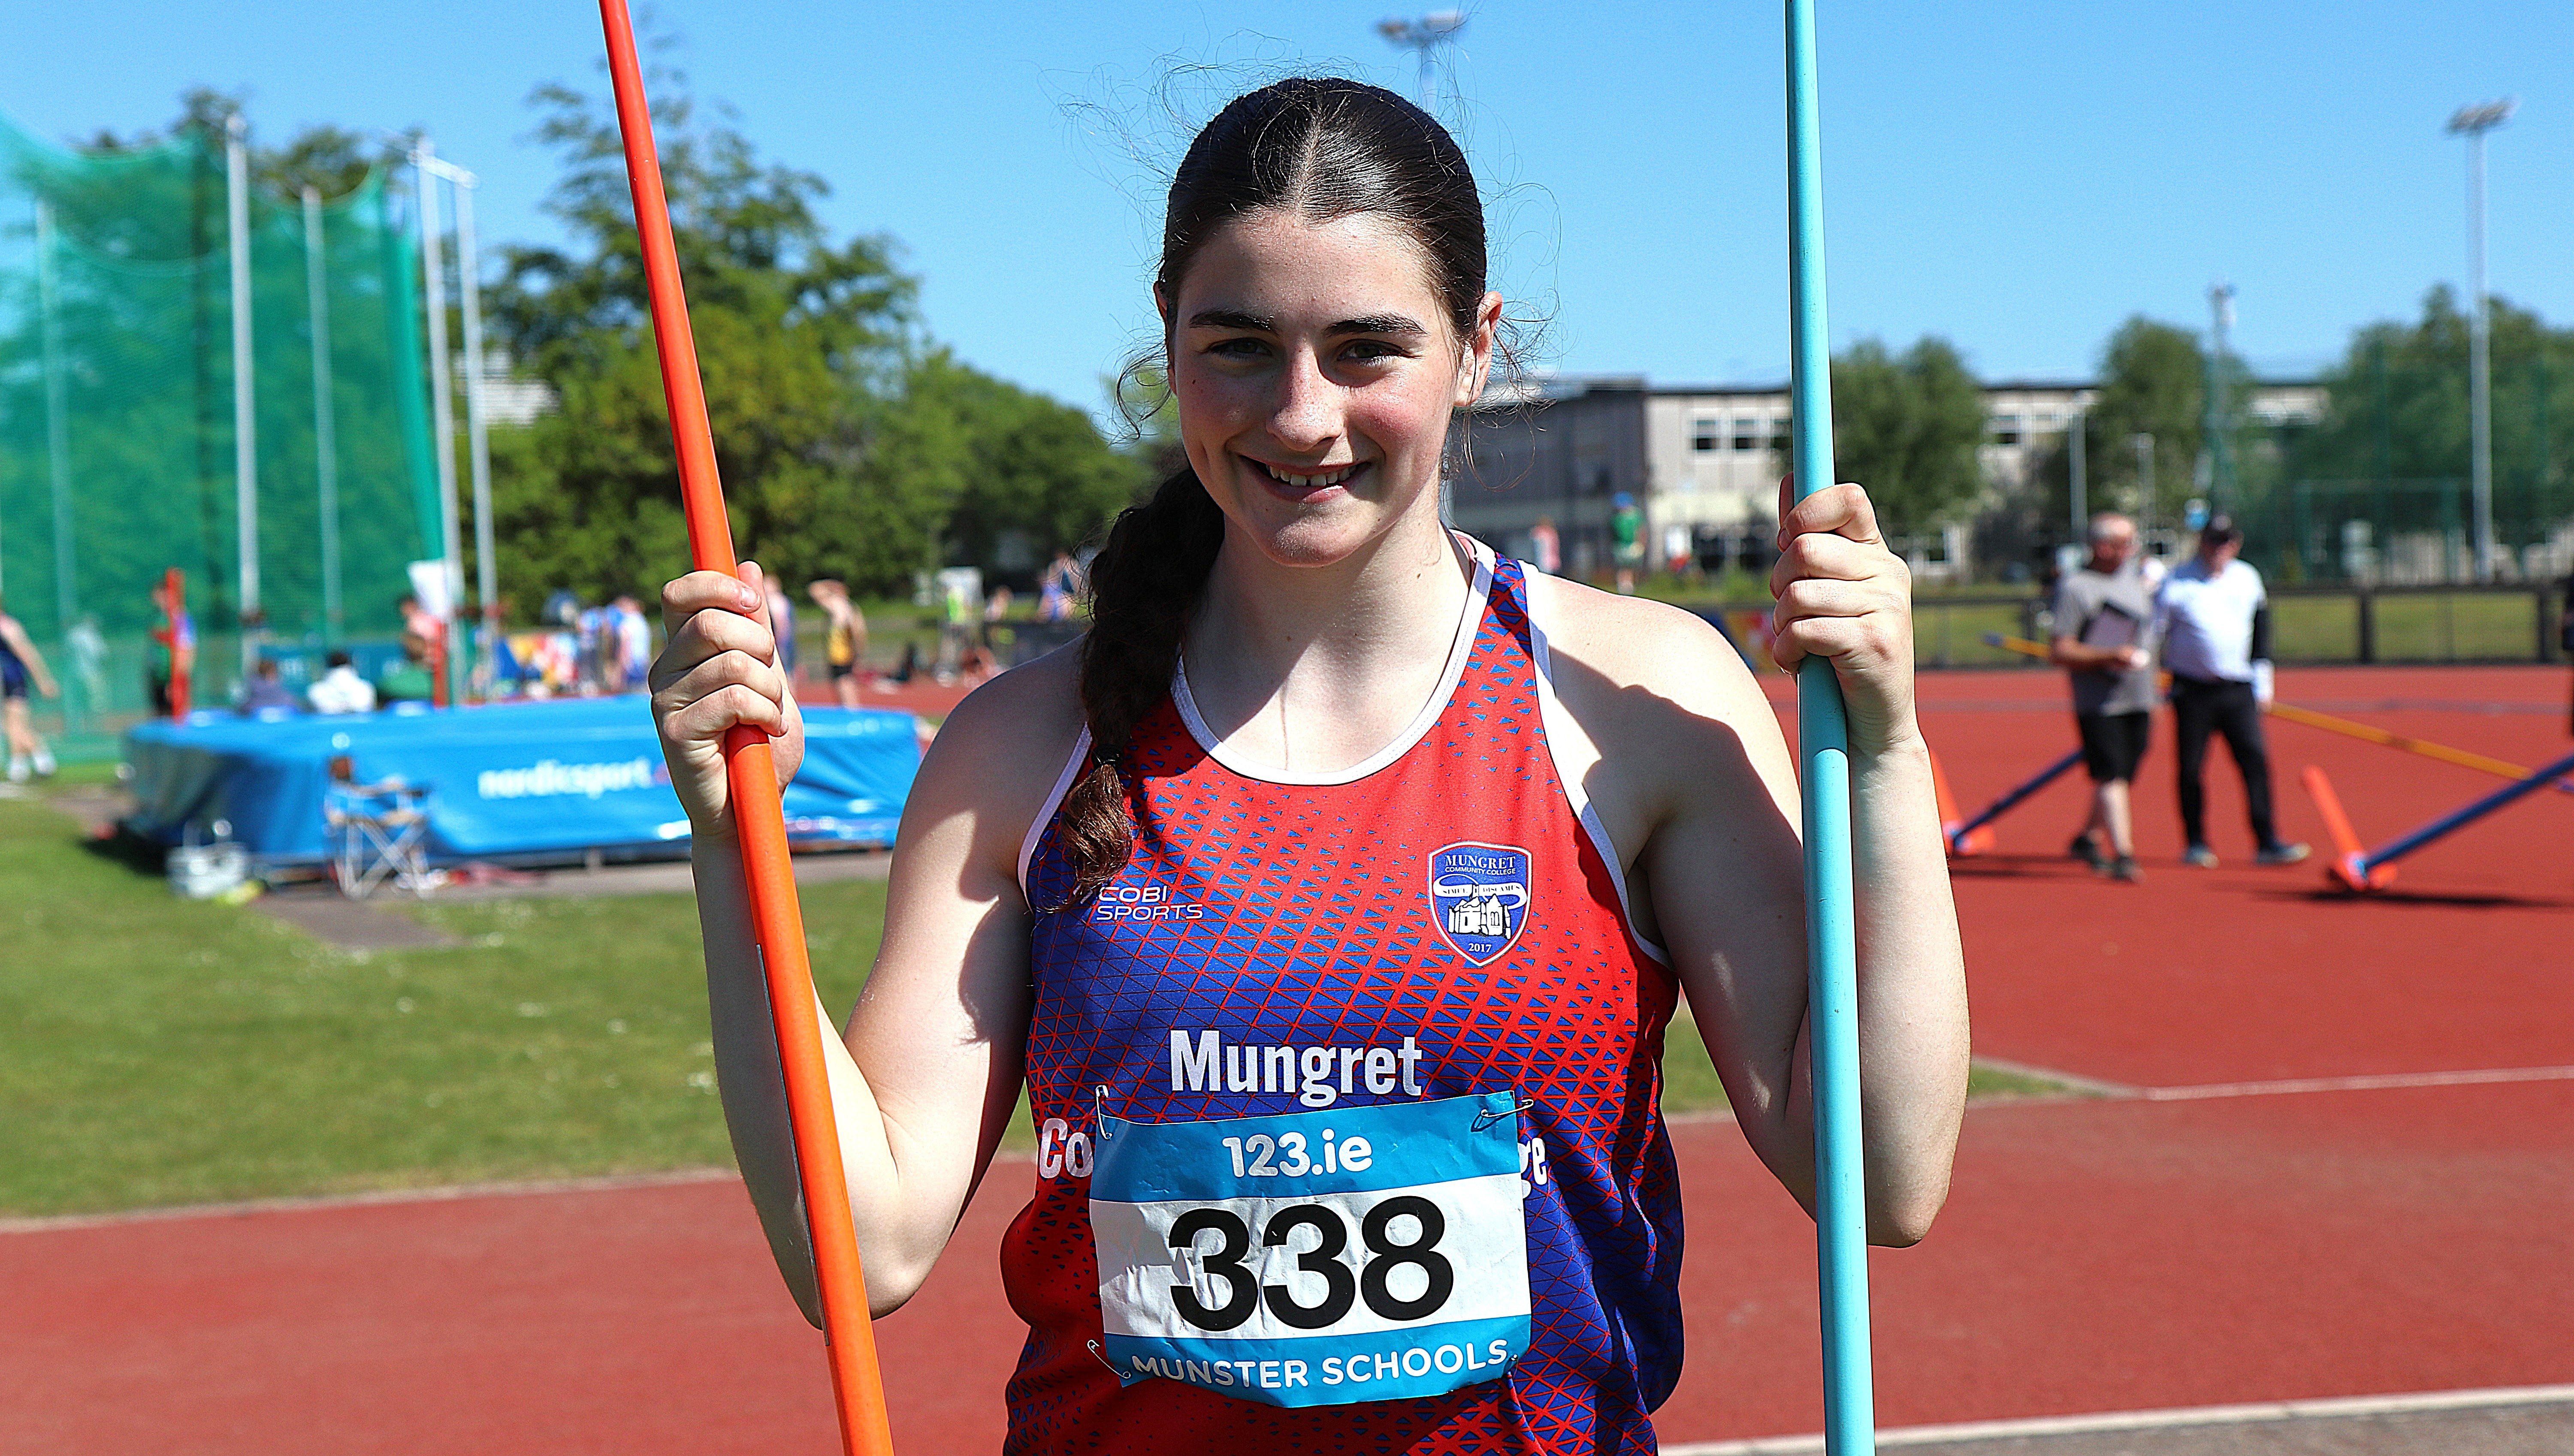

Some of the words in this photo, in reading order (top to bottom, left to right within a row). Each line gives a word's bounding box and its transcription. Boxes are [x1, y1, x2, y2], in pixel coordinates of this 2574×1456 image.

[1445, 855, 1516, 869] MUNGRET
[1444, 867, 1485, 875] COMMUNITY
[1099, 886, 1167, 903] COBI
[1097, 904, 1203, 920] SPORTS
[1468, 943, 1492, 953] 2017
[1170, 1030, 1422, 1107] Mungret
[1222, 1128, 1372, 1178] 123.ie
[1168, 1195, 1454, 1332] 338
[1132, 1355, 1308, 1388] MUNSTER
[1321, 1339, 1508, 1385] SCHOOLS
